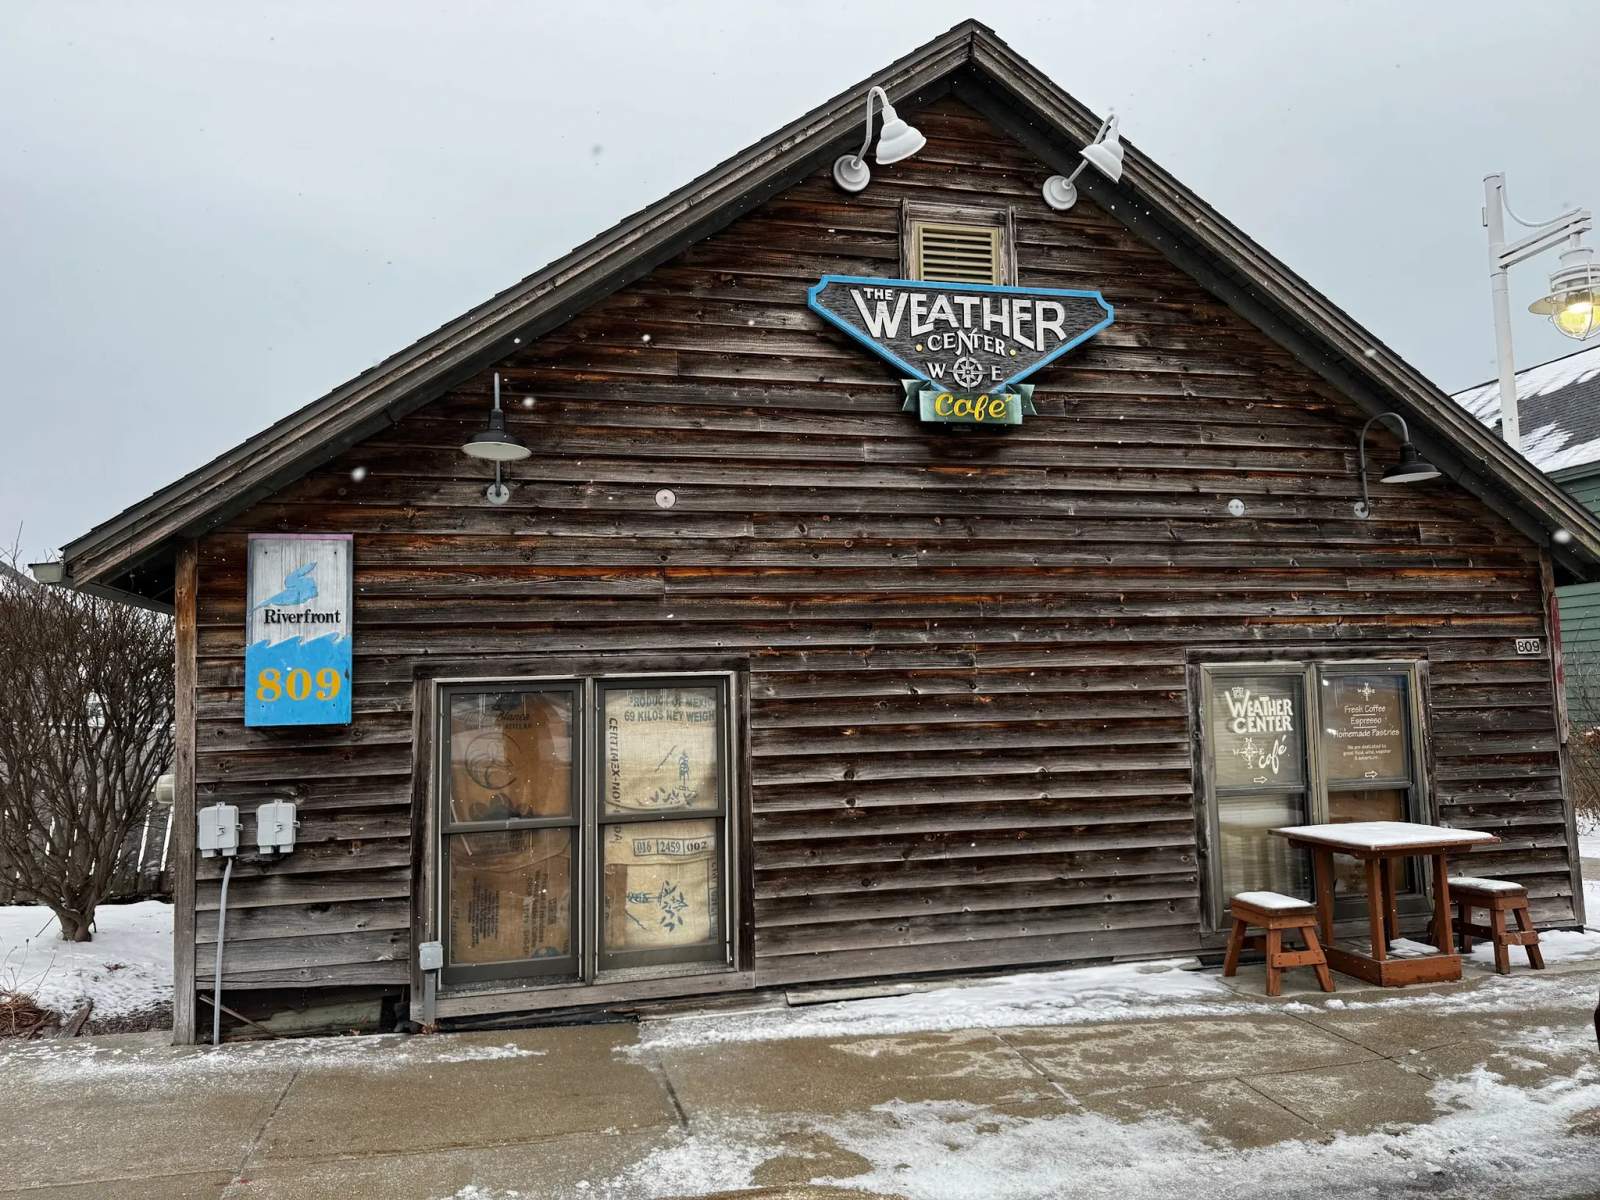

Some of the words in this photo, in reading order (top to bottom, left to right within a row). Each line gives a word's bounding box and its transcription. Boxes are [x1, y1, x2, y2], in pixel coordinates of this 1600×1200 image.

[863, 287, 893, 301] THE
[850, 289, 1067, 352] WEATHER
[927, 328, 1007, 357] CENTER
[926, 362, 947, 380] W
[991, 365, 1004, 381] E
[264, 608, 341, 625] Riverfront
[1517, 640, 1540, 652] 809
[256, 668, 341, 702] 809
[1224, 689, 1294, 718] WEATHER
[1344, 705, 1364, 713] Fresh
[1364, 704, 1386, 713] Coffee
[624, 711, 635, 722] 69
[1233, 715, 1294, 734] CENTER
[1259, 734, 1287, 774] café
[661, 841, 681, 853] 2459
